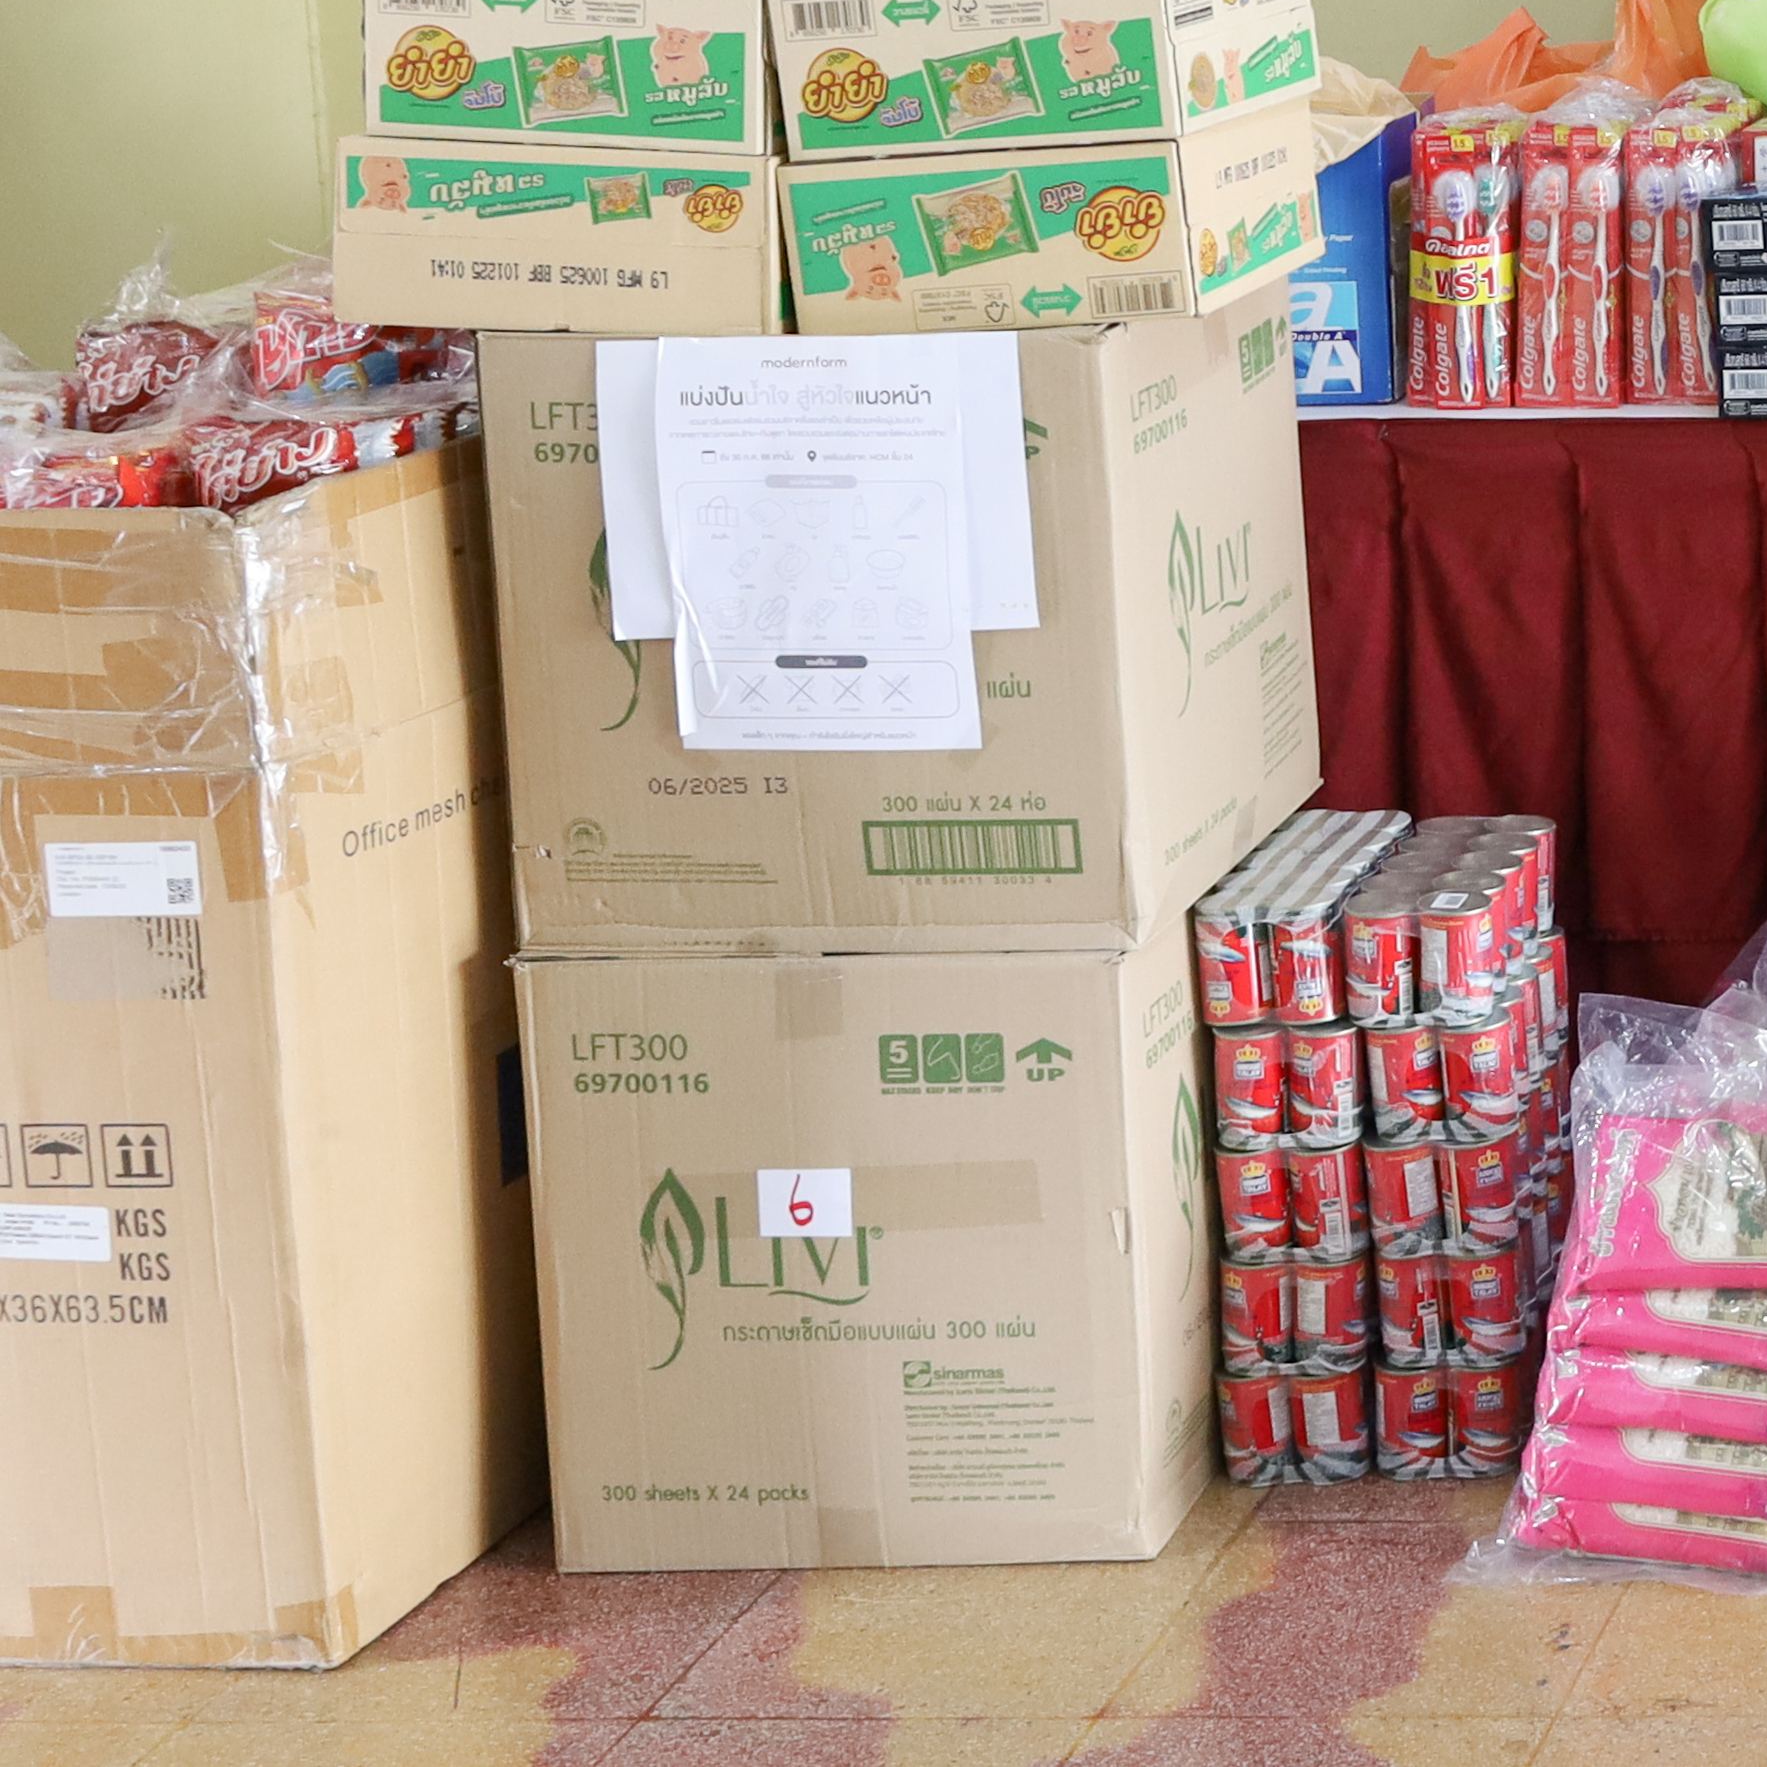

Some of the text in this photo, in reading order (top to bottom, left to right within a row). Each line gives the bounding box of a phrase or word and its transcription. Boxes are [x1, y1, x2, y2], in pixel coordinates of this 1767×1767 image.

[387, 40, 476, 91] ยำยำ
[802, 60, 888, 116] ยำยำ
[683, 191, 744, 226] ยำยำ
[471, 261, 520, 282] 101225
[526, 264, 552, 284] BBF
[559, 266, 609, 286] 100625
[616, 269, 643, 288] MFG
[1434, 262, 1499, 302] ฟรี 1
[761, 356, 847, 369] modernform
[1435, 323, 1451, 397] Colgate
[1571, 316, 1586, 391] Colgate
[1631, 315, 1645, 389] Colgate
[680, 379, 789, 407] แบ่งปันน้ำใจ
[1130, 375, 1177, 422] LFT300
[1133, 409, 1188, 454] 69700116
[986, 677, 1032, 701] แผ่น
[648, 776, 748, 796] 06/2025
[882, 797, 916, 813] 300
[926, 794, 962, 814] แผ่น
[988, 797, 1014, 813] 24
[1021, 792, 1047, 813] ห่อ
[342, 796, 467, 858] Office mesh
[572, 1033, 688, 1061] LFT300
[889, 1040, 908, 1065] 5
[574, 1072, 710, 1094] 69700116
[1026, 1068, 1065, 1082] UP
[790, 1174, 812, 1227] 6
[115, 1208, 167, 1238] KGS
[119, 1253, 171, 1282] KGS
[723, 1318, 1037, 1343] กระดาษเช็ดมือแบบแผ่น 300 แผ่น
[934, 1367, 1004, 1380] sinarmas
[602, 1486, 636, 1501] 300
[644, 1484, 701, 1502] sheets
[726, 1486, 750, 1501] 24
[757, 1484, 809, 1506] packs
